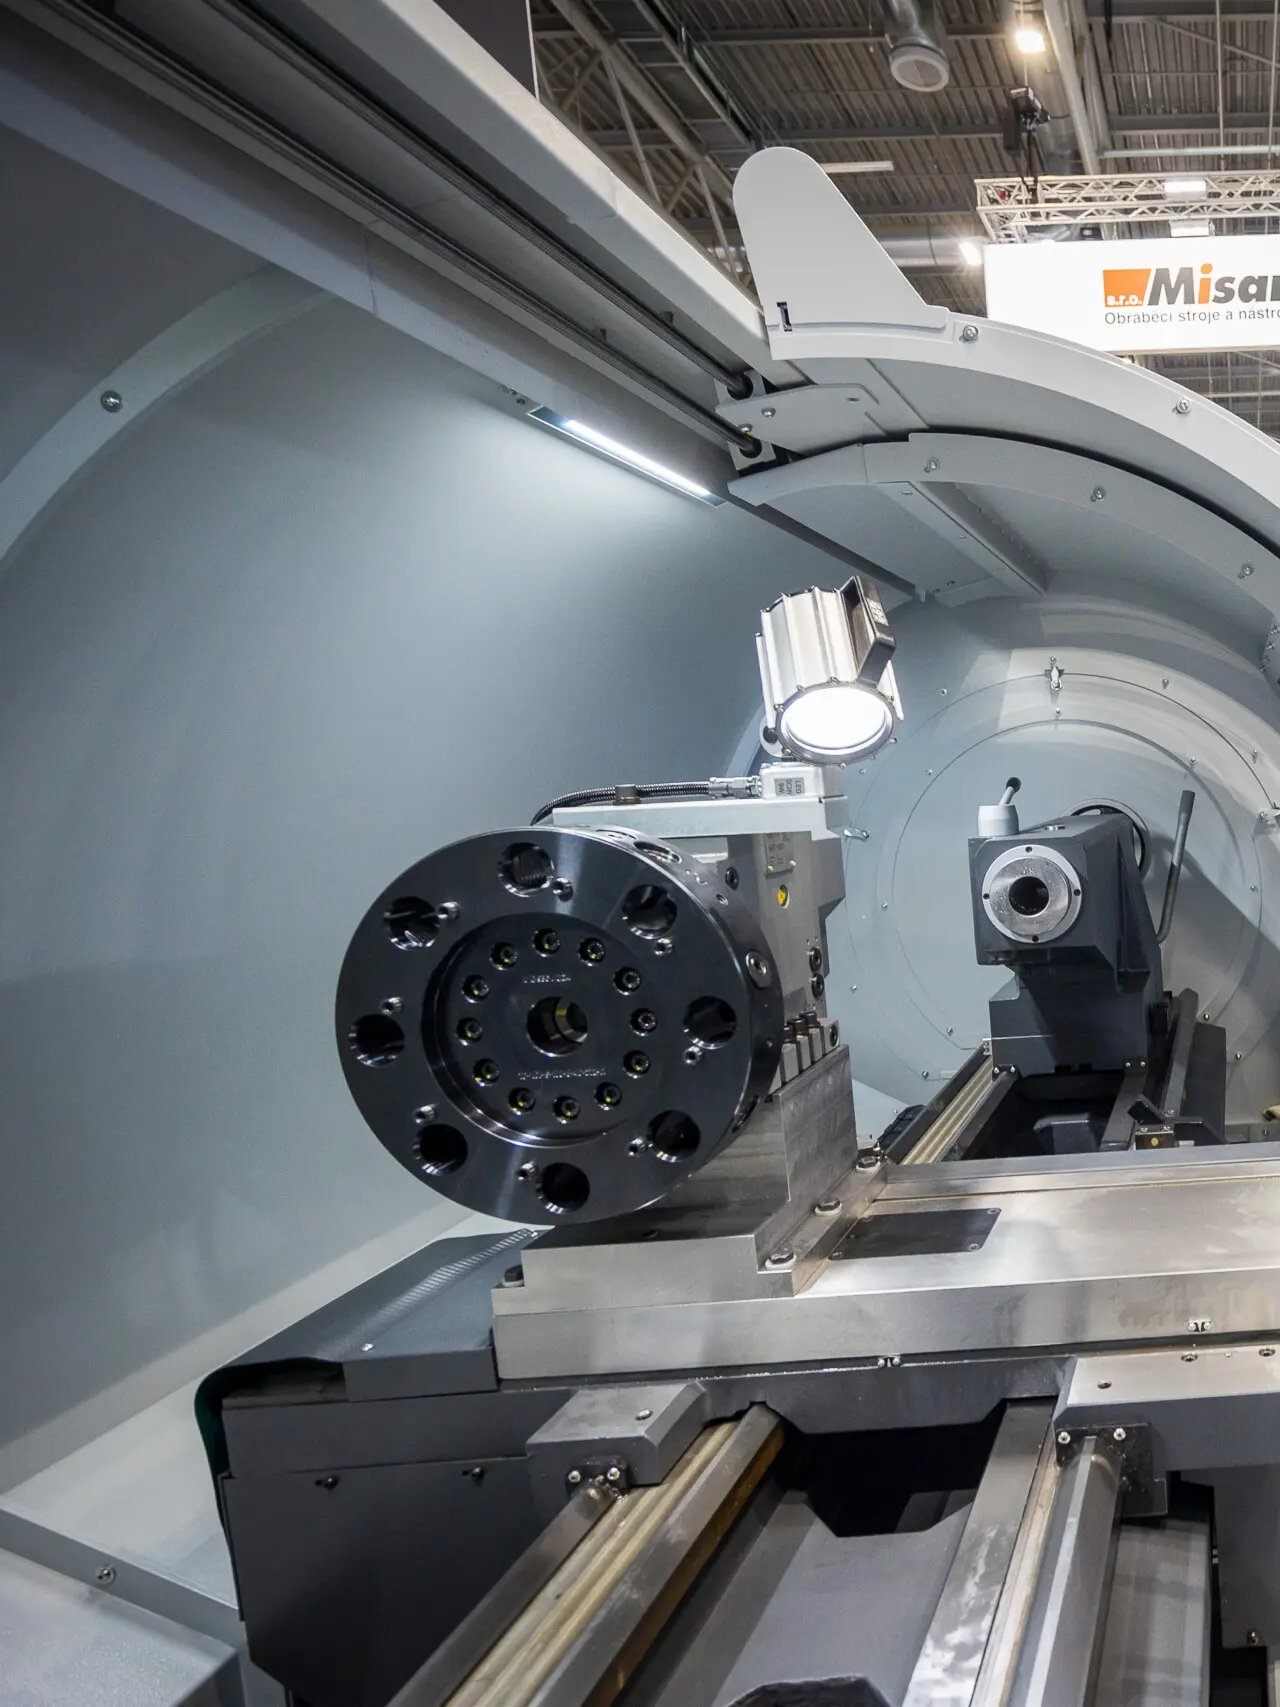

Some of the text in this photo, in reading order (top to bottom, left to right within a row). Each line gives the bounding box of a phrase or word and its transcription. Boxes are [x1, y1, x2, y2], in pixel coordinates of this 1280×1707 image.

[1107, 294, 1143, 306] s.r.o.
[1178, 310, 1220, 324] stroje
[1225, 312, 1234, 321] a
